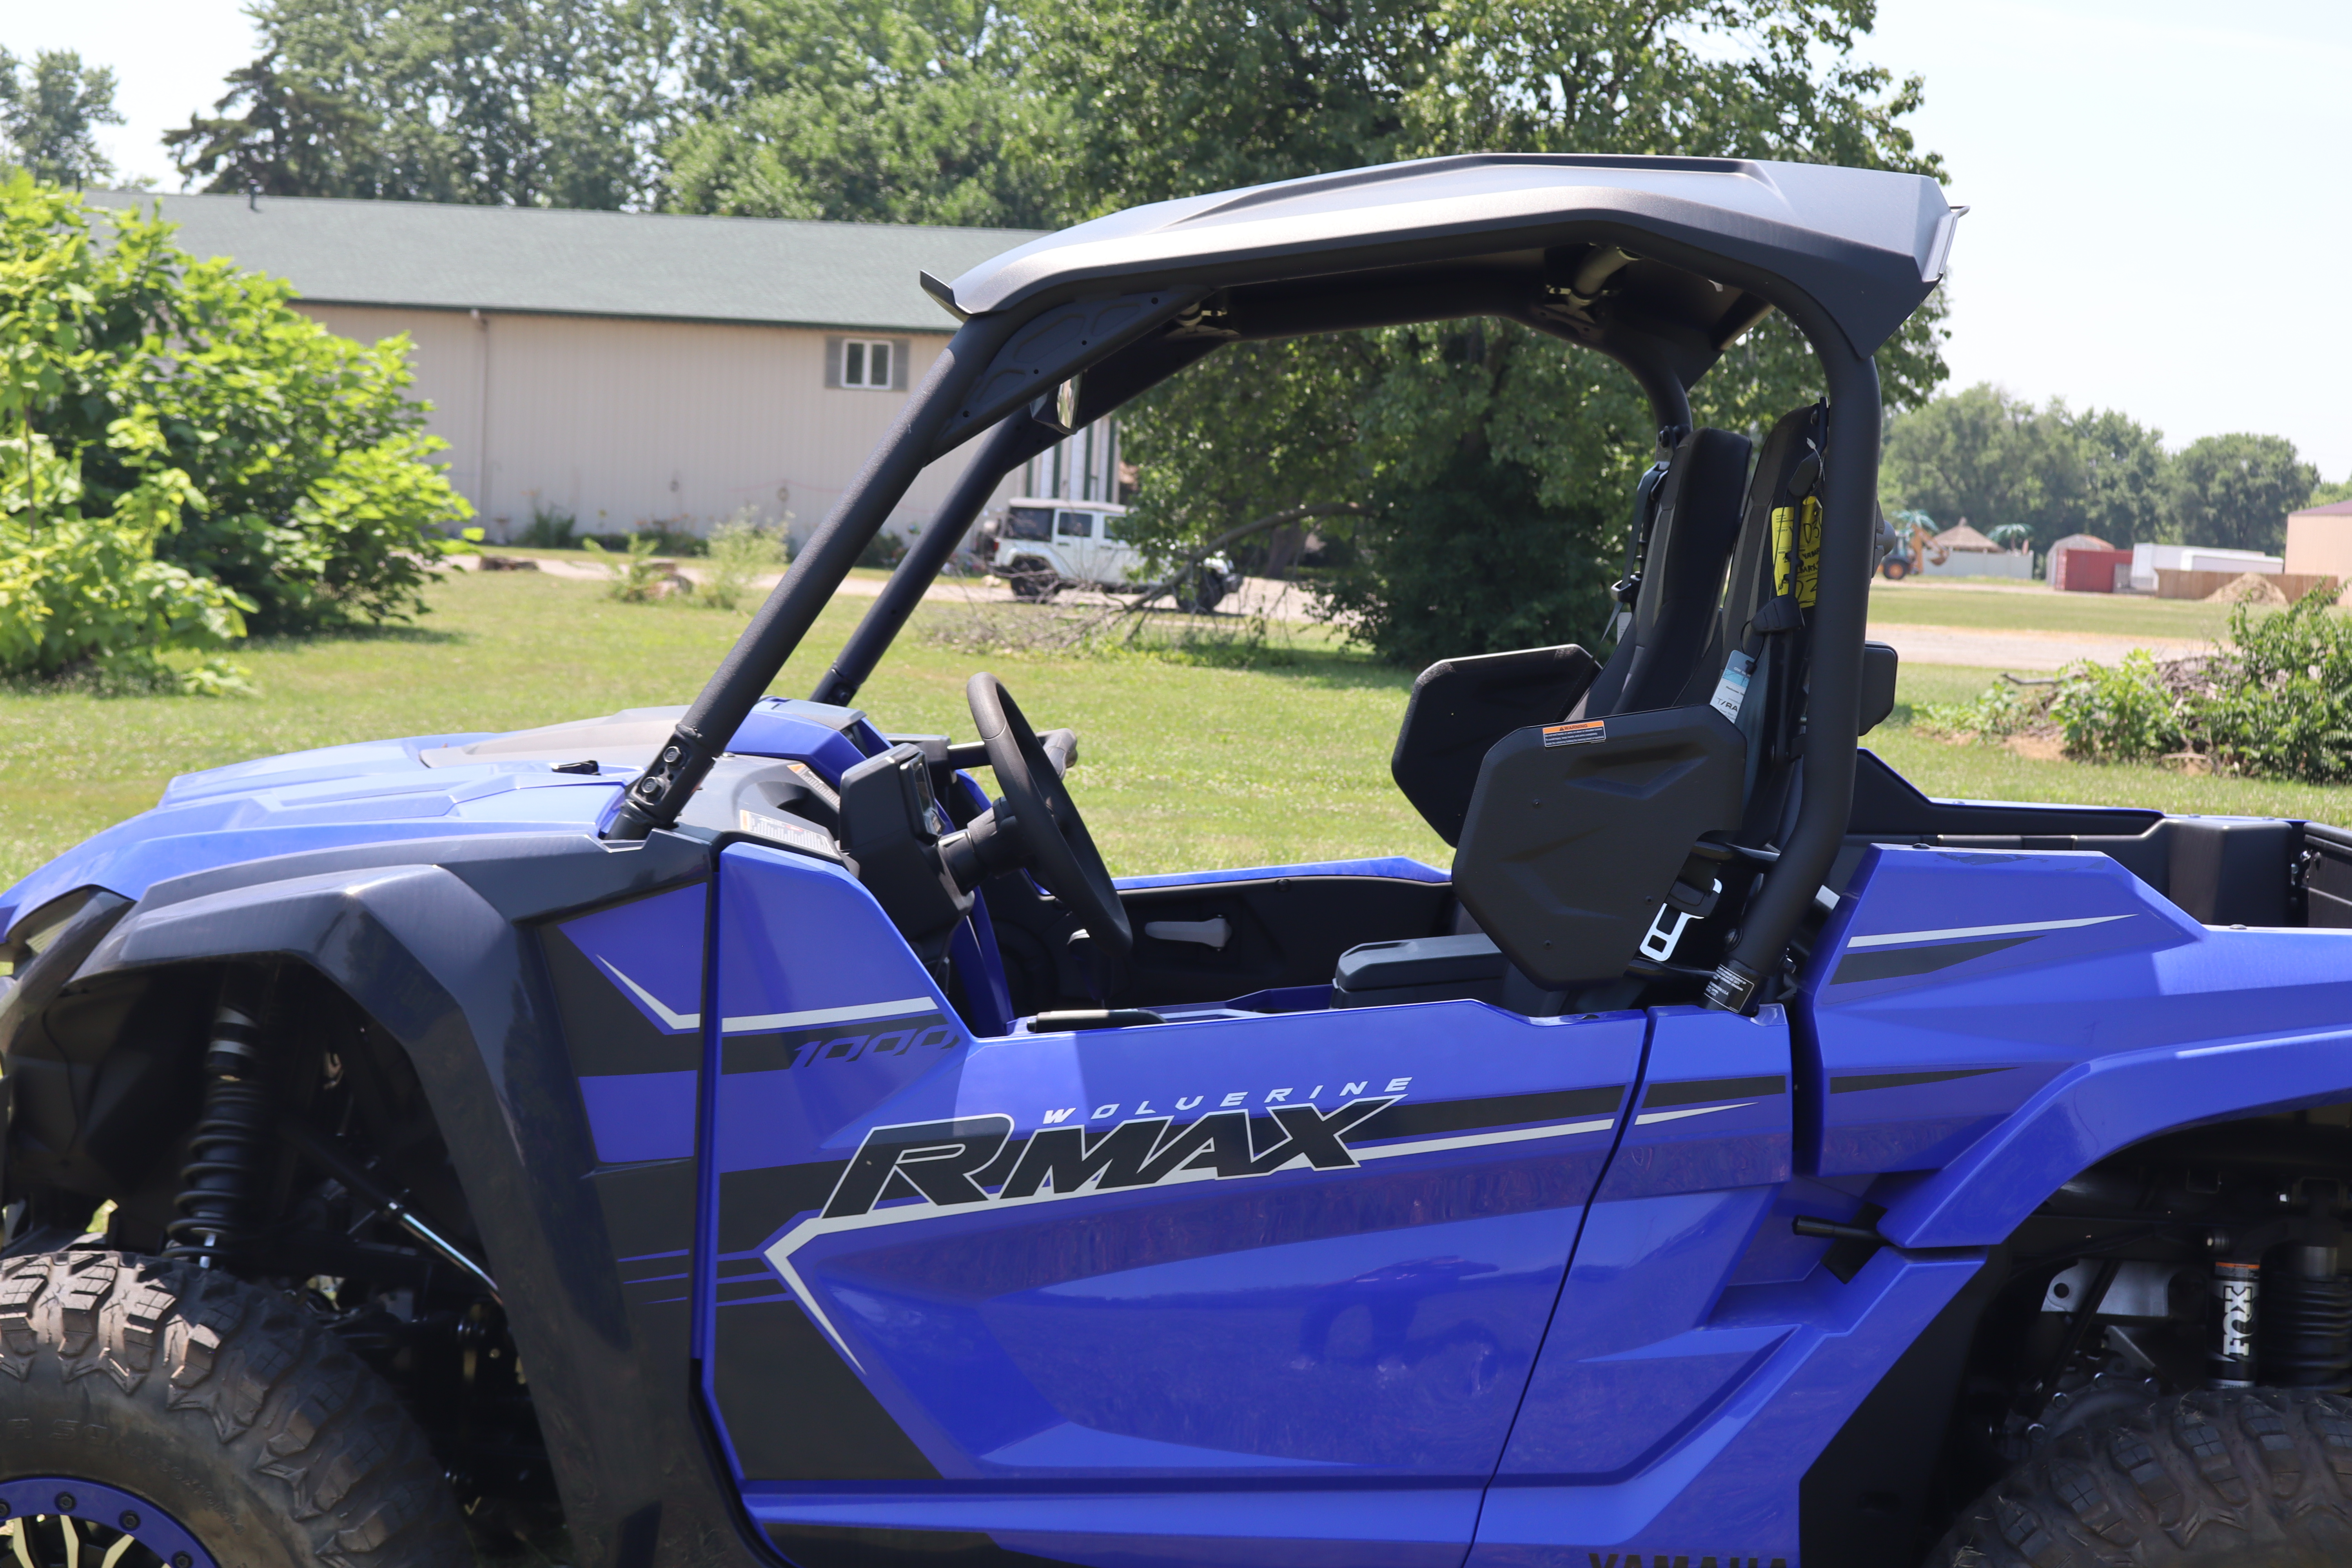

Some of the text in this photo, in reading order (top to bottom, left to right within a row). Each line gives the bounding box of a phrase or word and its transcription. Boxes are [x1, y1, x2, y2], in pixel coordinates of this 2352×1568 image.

[788, 1023, 959, 1070] 1000
[819, 1093, 1410, 1220] RMAX
[2223, 1286, 2253, 1356] FOX
